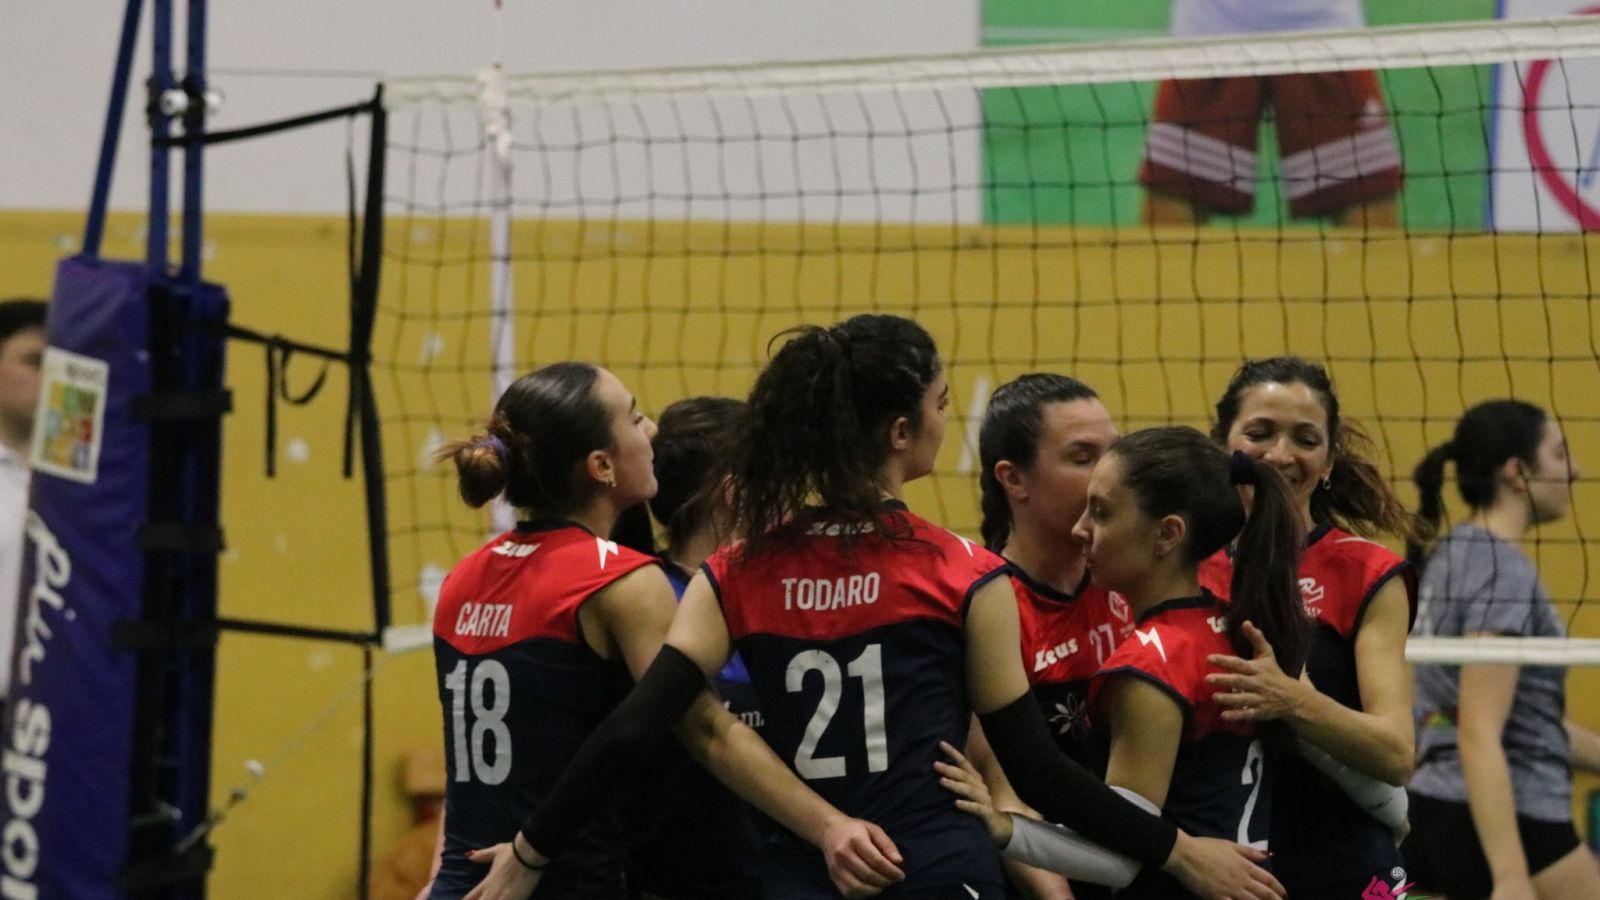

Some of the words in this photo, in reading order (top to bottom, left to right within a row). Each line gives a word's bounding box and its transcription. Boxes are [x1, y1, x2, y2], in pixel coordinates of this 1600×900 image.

[782, 571, 881, 611] TODARO
[454, 602, 513, 637] CARTA
[1033, 637, 1079, 673] Zeus
[445, 658, 513, 786] 18
[784, 643, 889, 780] 21
